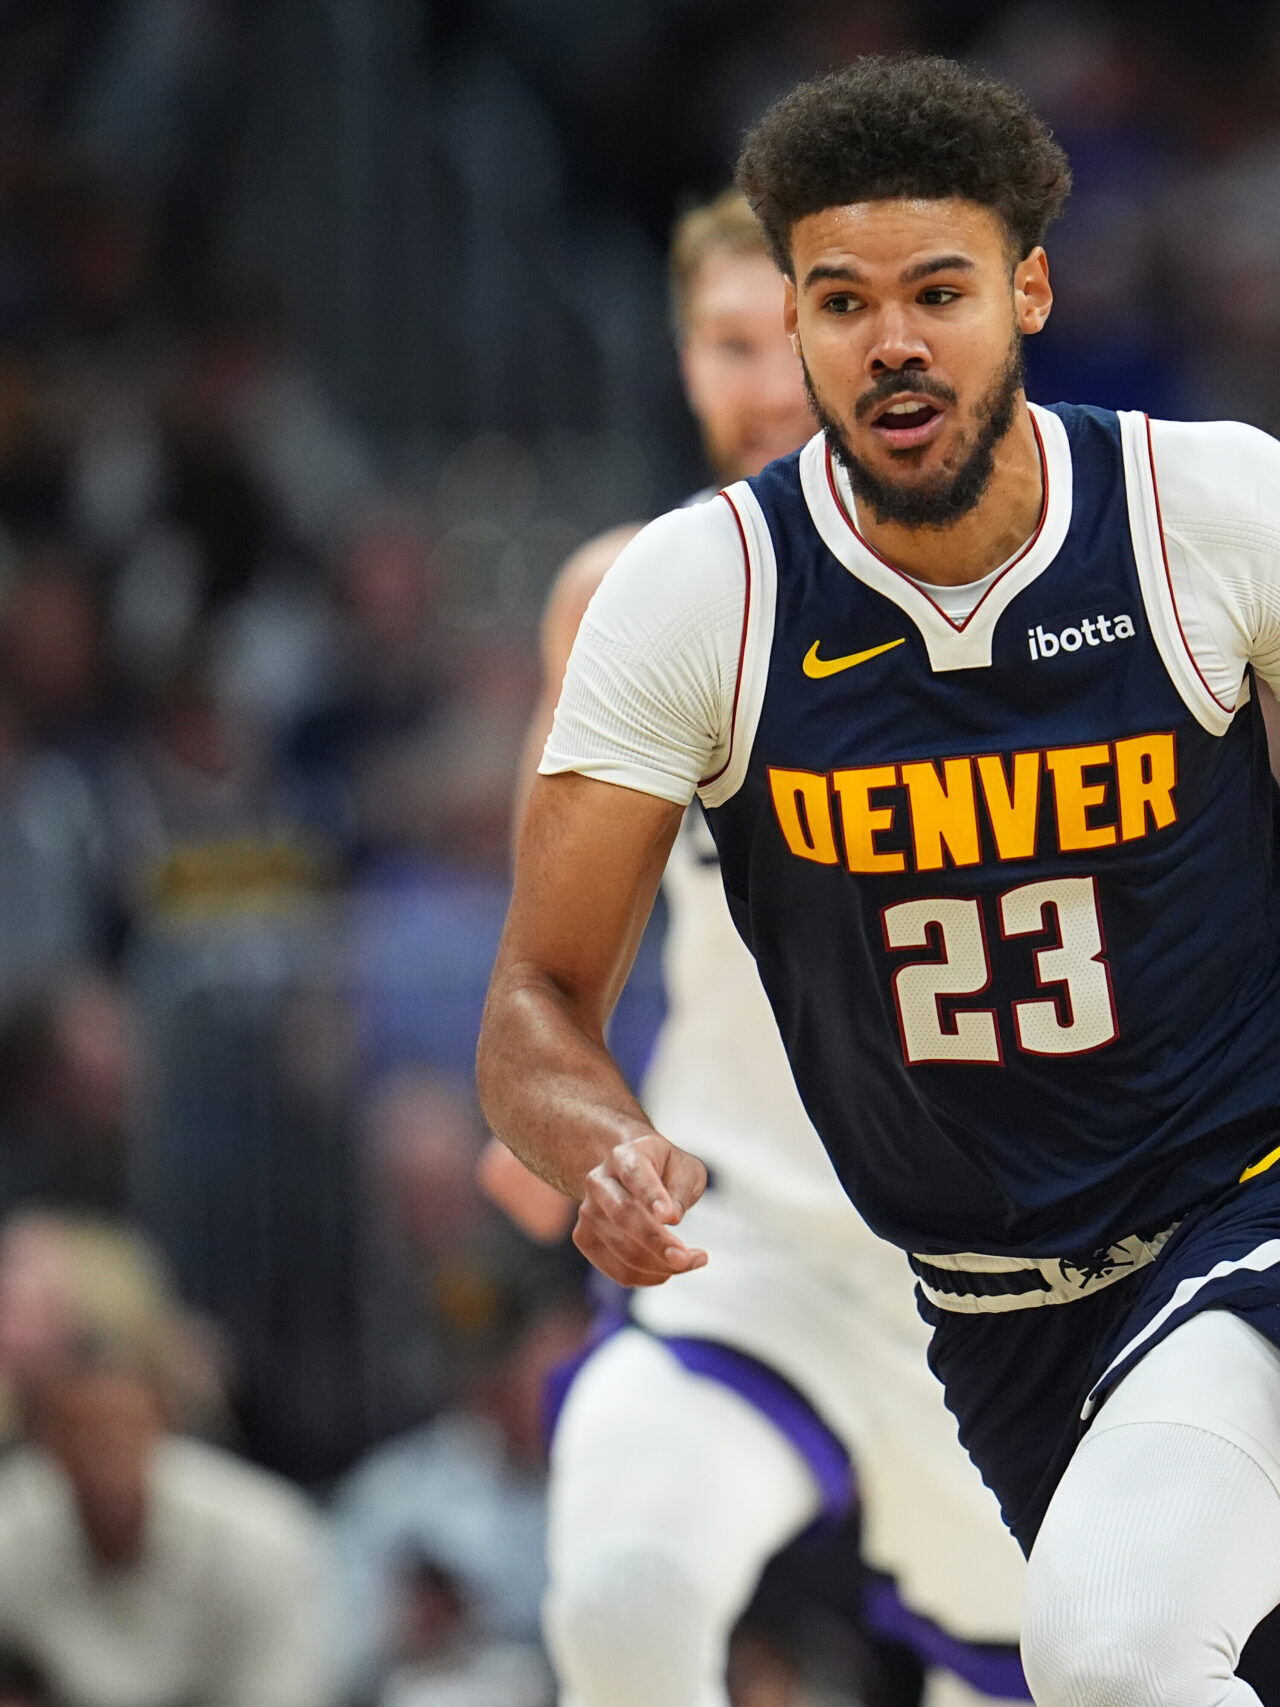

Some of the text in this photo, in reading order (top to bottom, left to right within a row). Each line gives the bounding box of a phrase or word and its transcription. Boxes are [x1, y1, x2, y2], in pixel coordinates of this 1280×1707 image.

[1028, 612, 1137, 661] ibotta
[766, 730, 1178, 875] DENVER
[879, 875, 1121, 1068] 23
